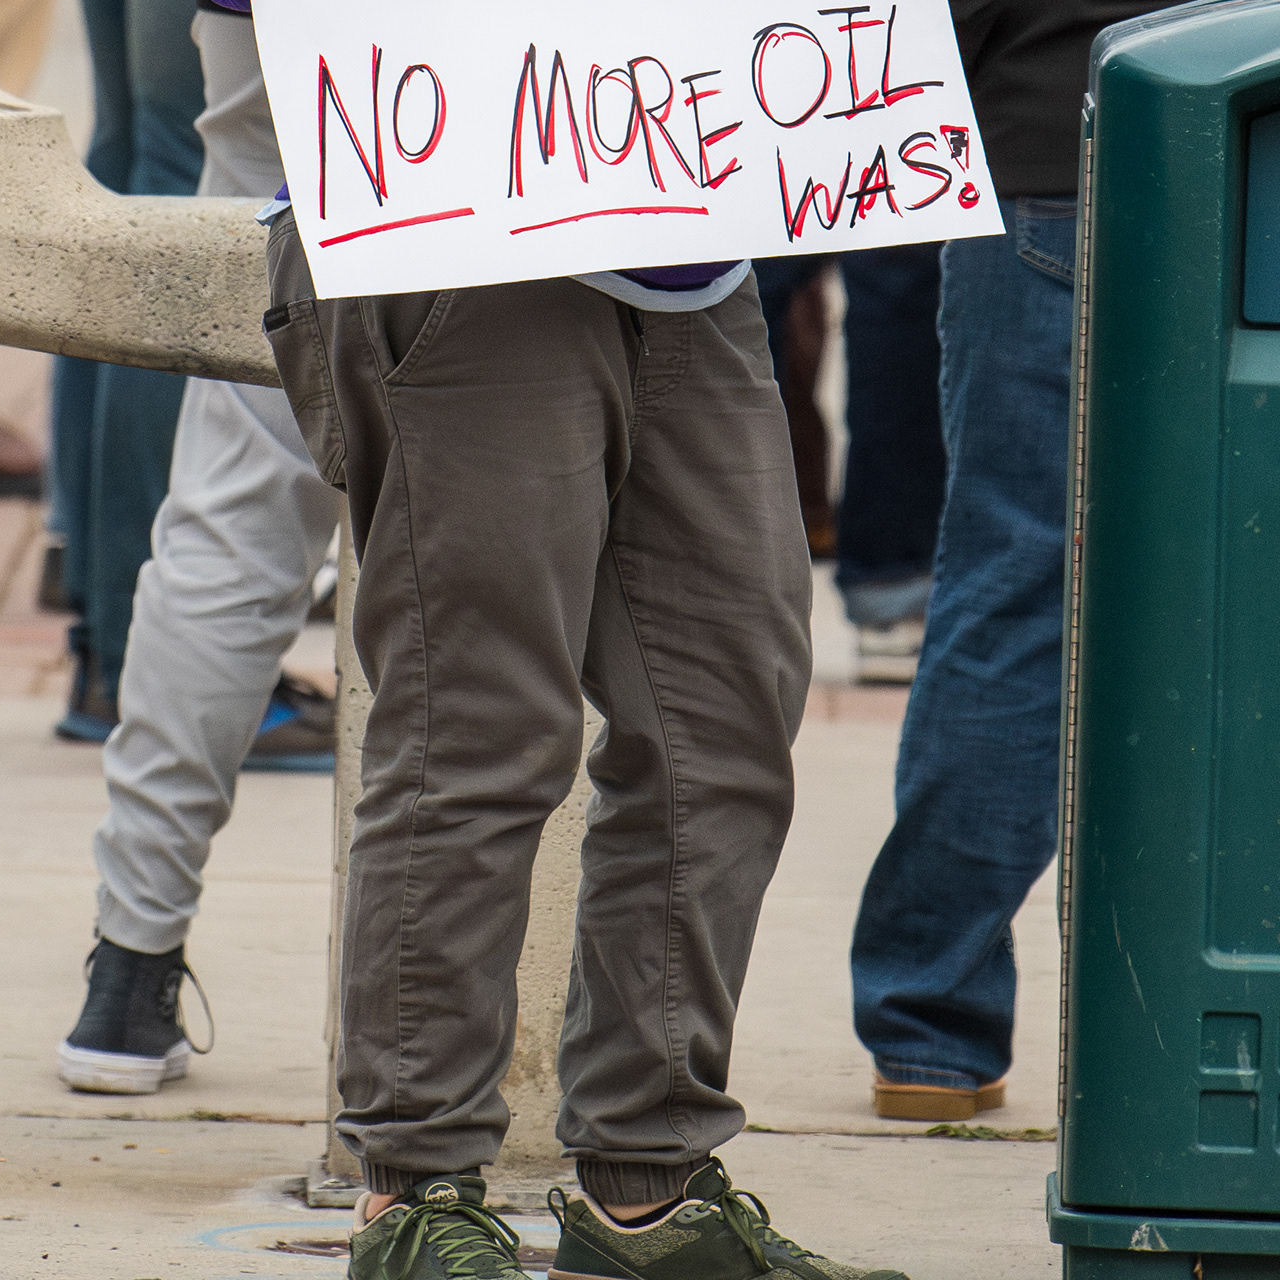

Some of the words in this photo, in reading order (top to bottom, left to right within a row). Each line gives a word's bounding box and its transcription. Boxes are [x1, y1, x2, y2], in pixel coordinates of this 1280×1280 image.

[317, 43, 448, 220] NO
[507, 41, 743, 198] MORE
[751, 4, 945, 131] OIL
